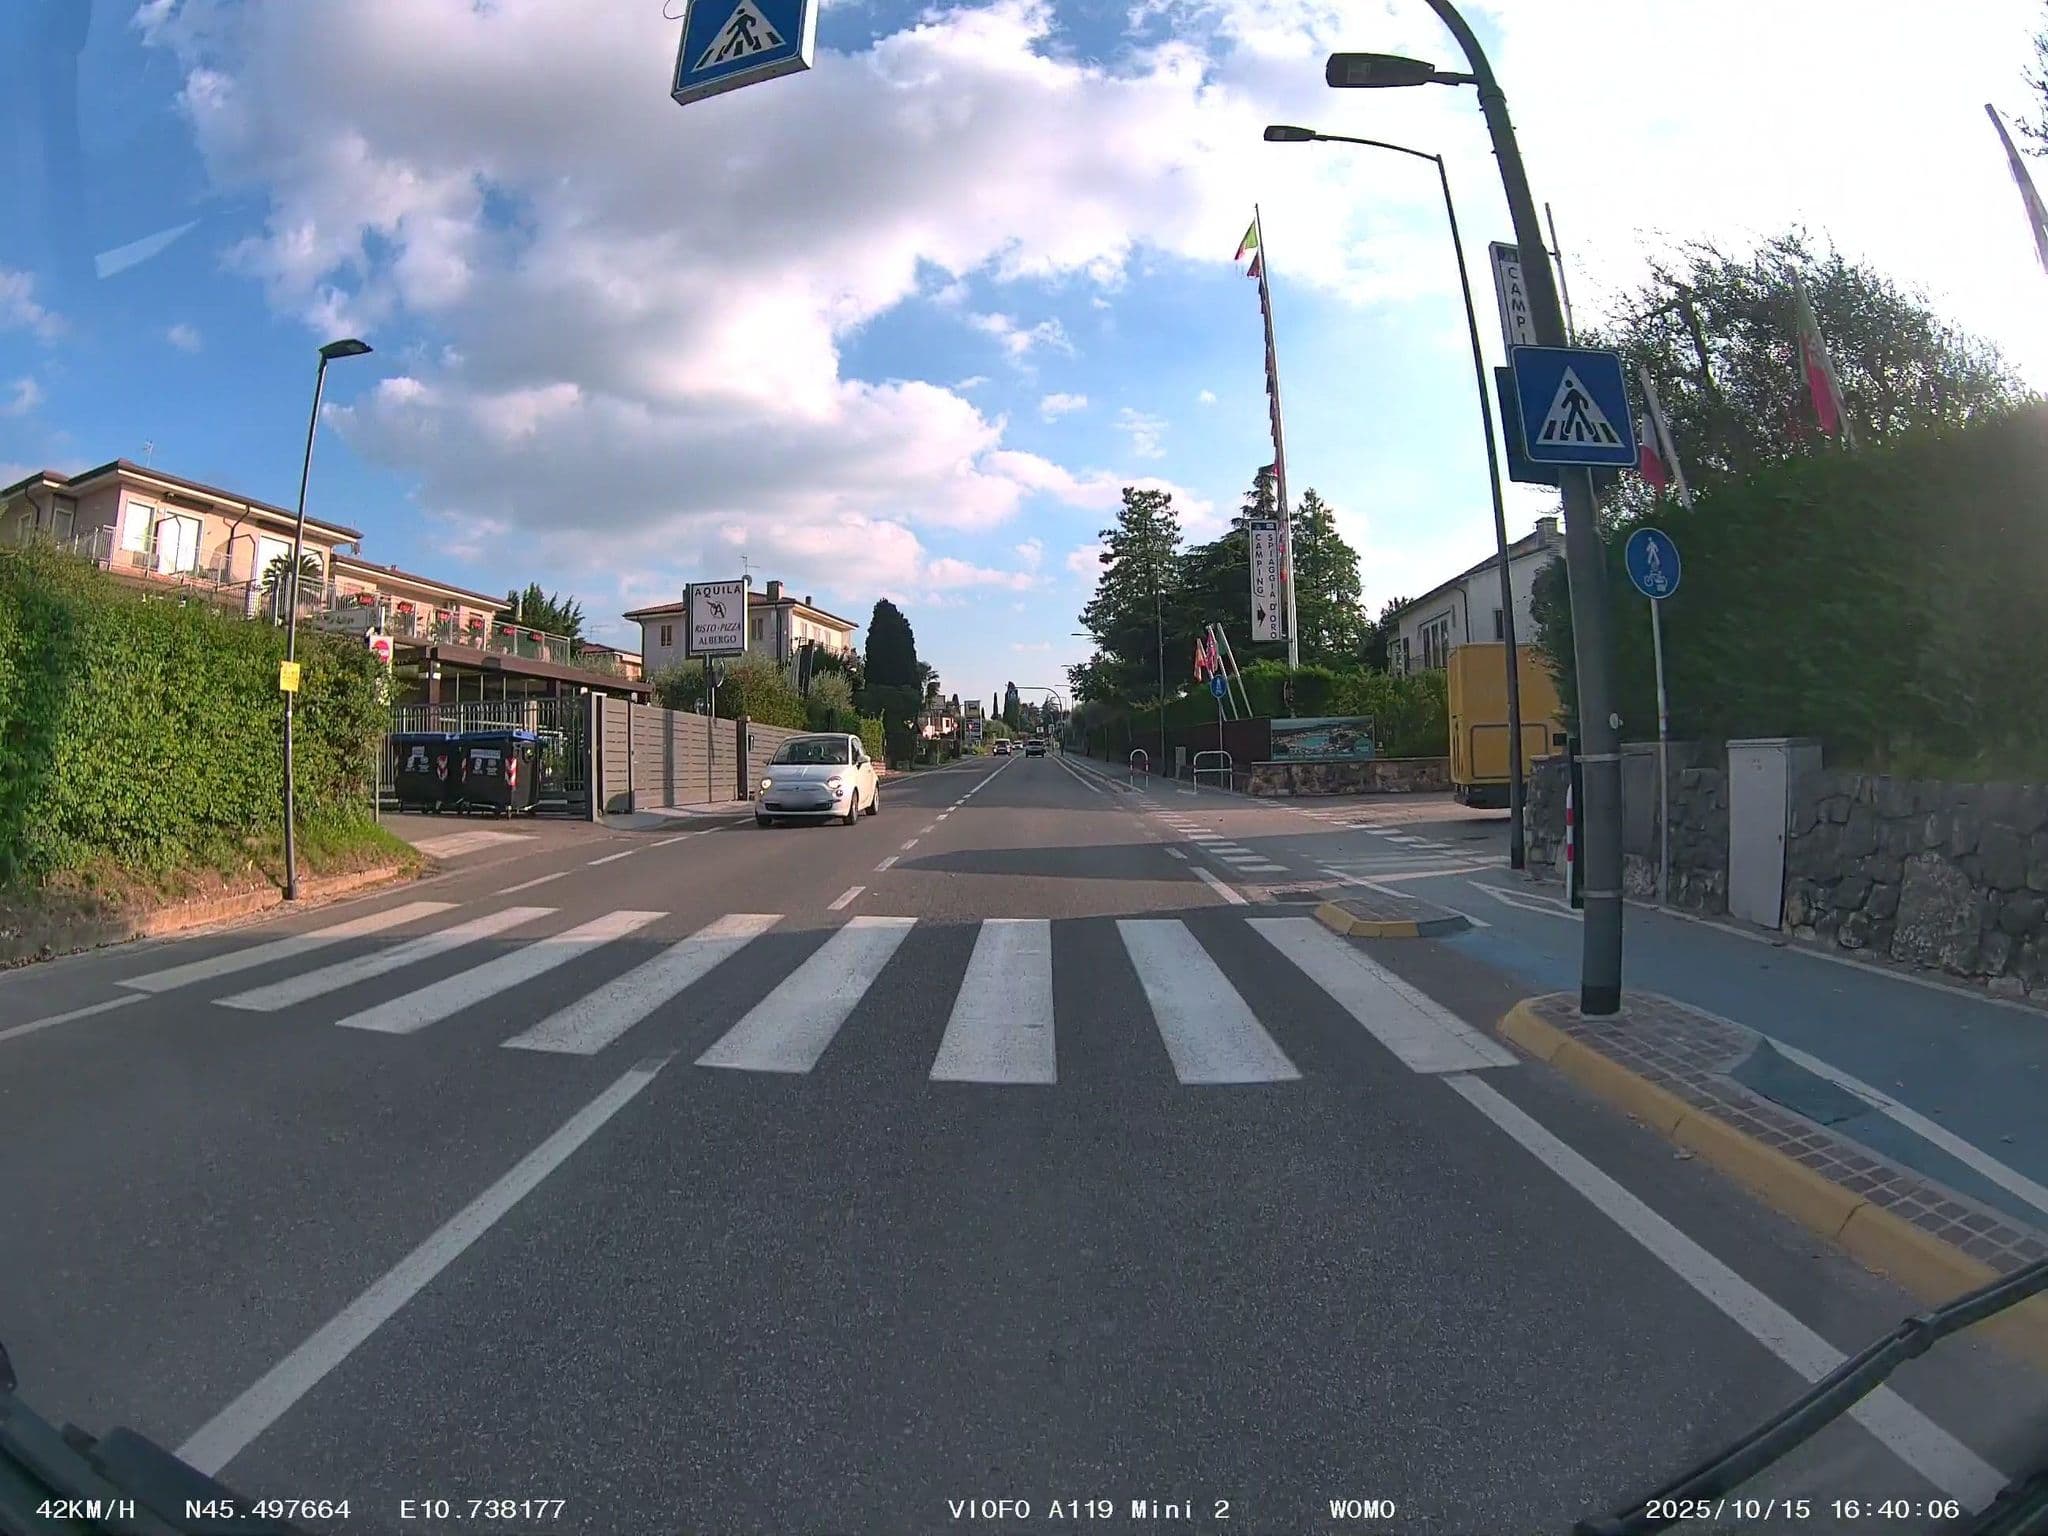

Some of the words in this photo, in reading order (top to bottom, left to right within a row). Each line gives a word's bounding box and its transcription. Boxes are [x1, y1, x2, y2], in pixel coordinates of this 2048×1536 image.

[1508, 266, 1526, 345] CAMPI
[1255, 533, 1264, 594] CAMPING
[1267, 533, 1276, 598] SPIAGGIA
[695, 585, 741, 598] AQUILA
[699, 635, 737, 646] ALBERGO
[1269, 602, 1278, 639] D'ORO
